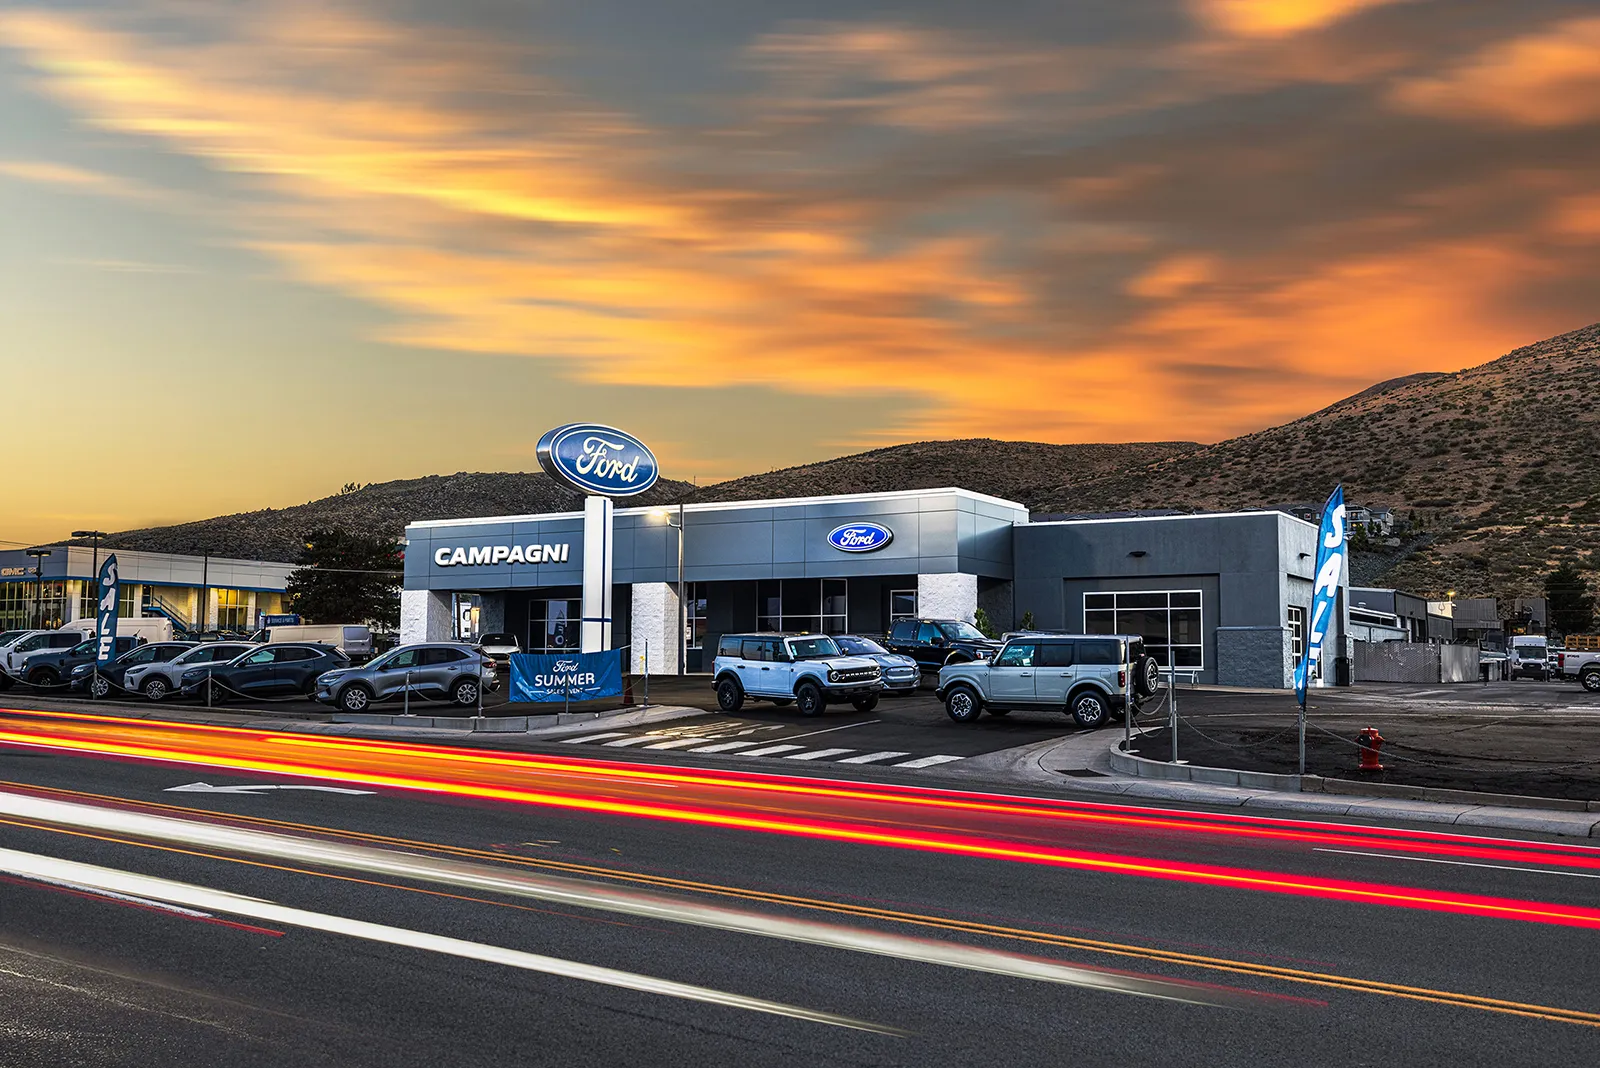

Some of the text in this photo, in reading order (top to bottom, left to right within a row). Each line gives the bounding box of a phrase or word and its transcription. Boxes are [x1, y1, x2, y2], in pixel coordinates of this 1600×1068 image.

[576, 436, 640, 483] Ford
[840, 529, 876, 546] Ford
[434, 543, 569, 566] CAMPAGNI
[98, 562, 117, 660] SALE
[552, 660, 579, 673] Ford
[534, 672, 595, 687] SUMMER
